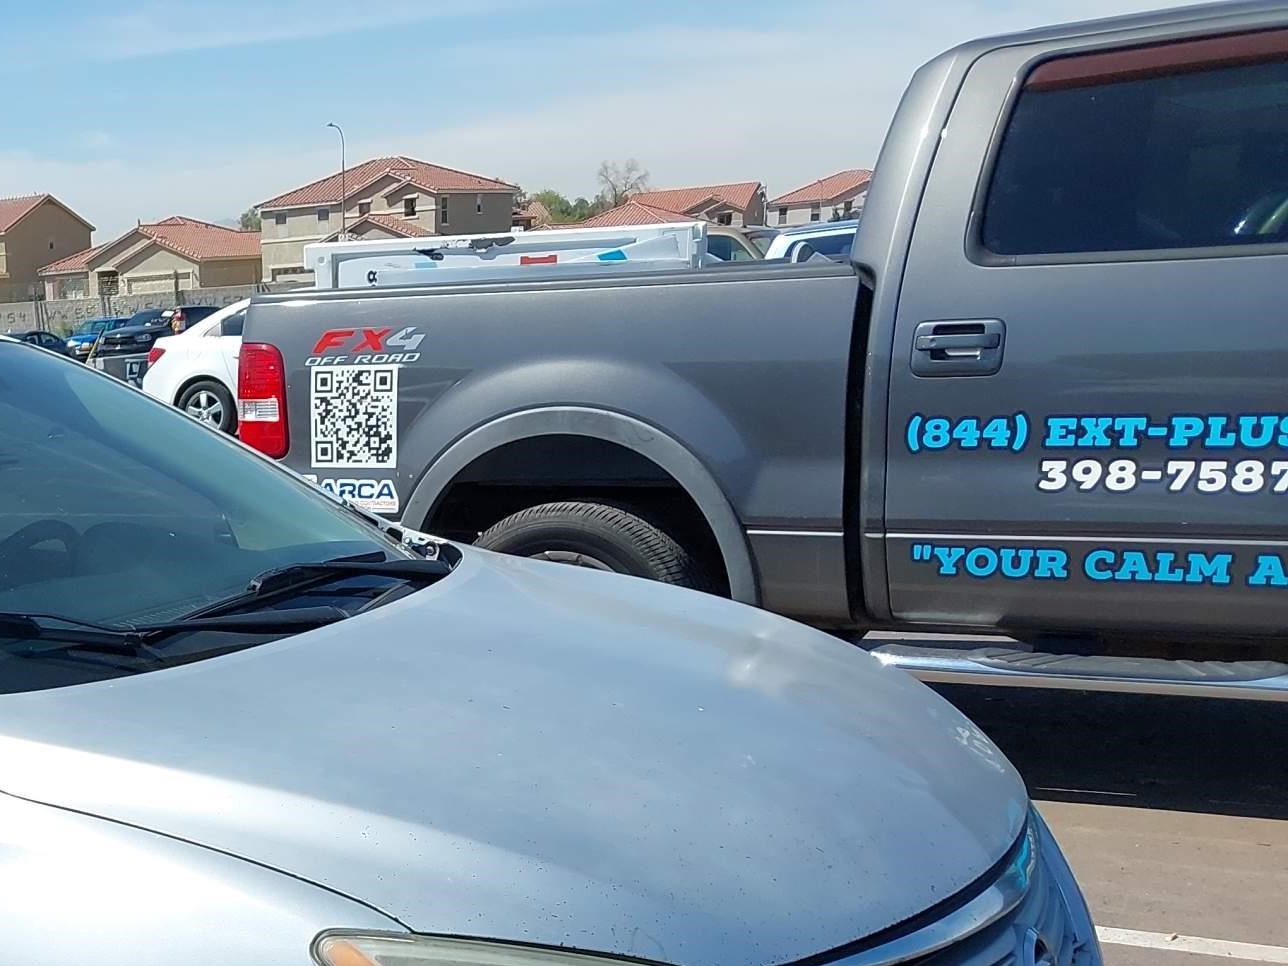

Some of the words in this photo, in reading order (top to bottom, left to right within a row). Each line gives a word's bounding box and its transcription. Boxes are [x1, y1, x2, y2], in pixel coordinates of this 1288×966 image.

[312, 326, 426, 354] FX4
[305, 355, 348, 367] OFF
[354, 352, 421, 365] ROAD
[906, 414, 1028, 452] (844)
[1038, 459, 1288, 492] 398-7587
[912, 544, 1068, 579] "YOUR
[1083, 550, 1233, 585] CALM
